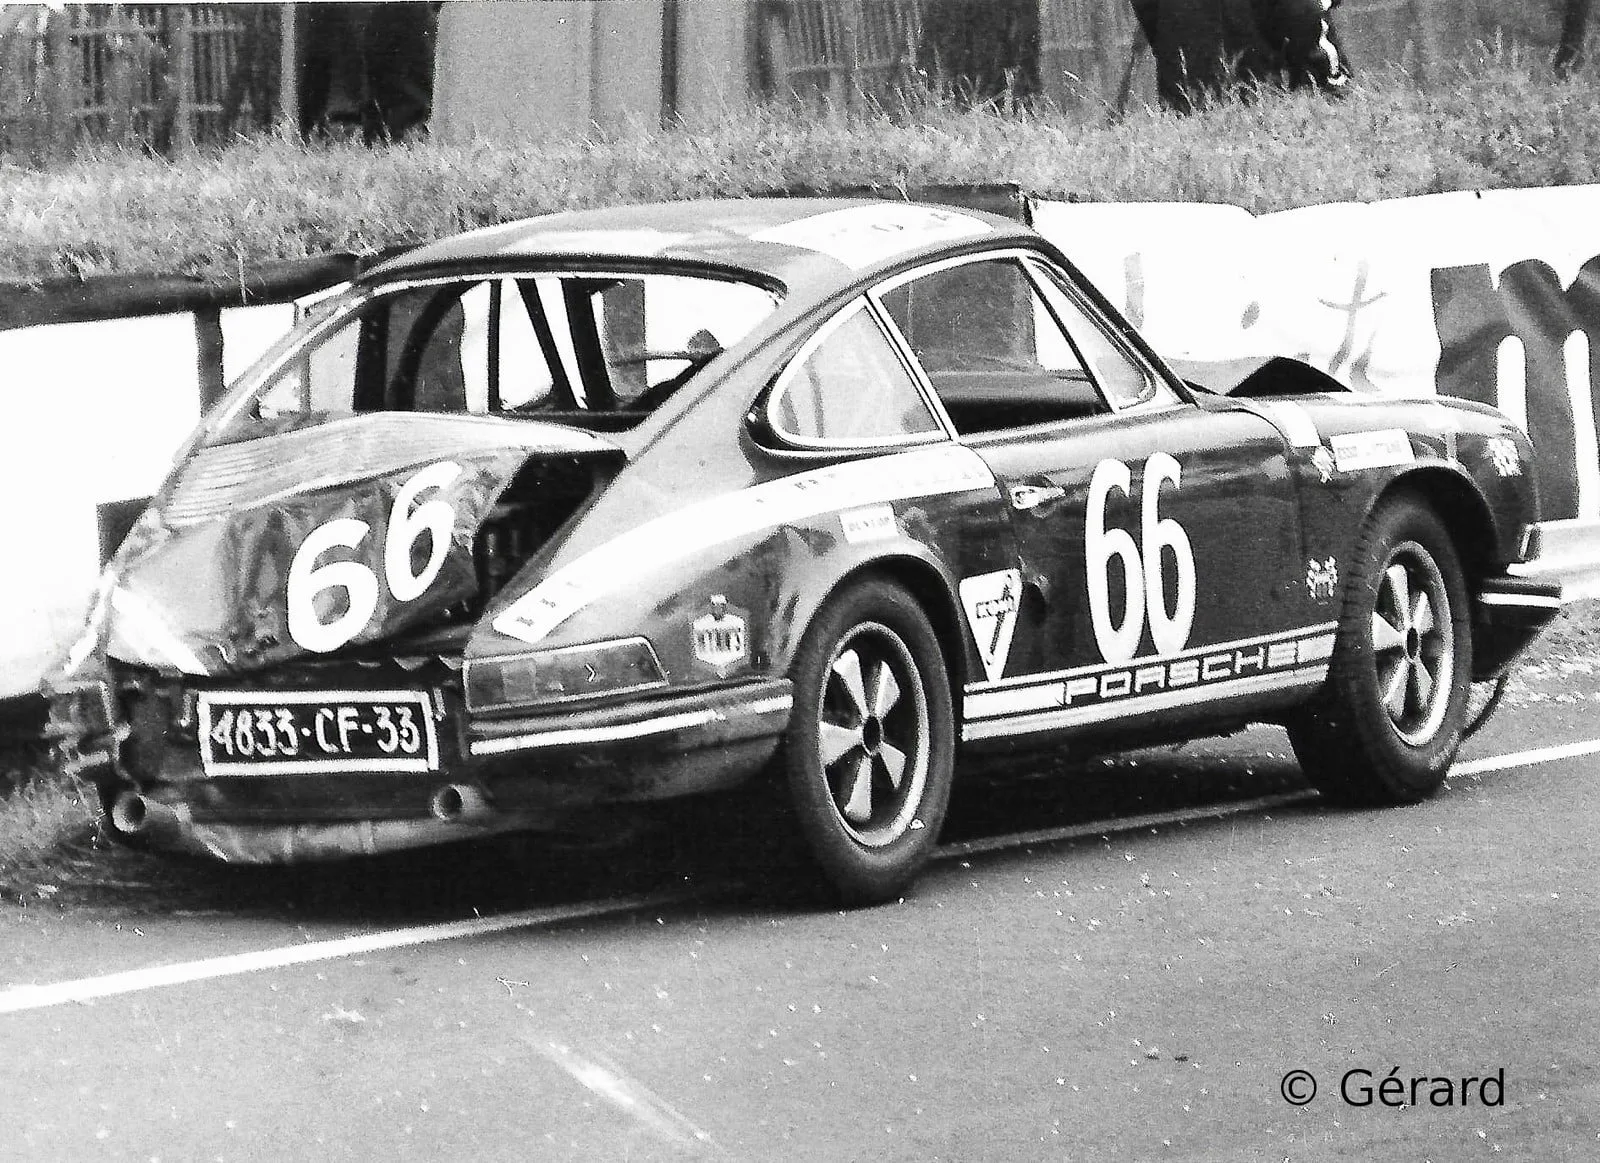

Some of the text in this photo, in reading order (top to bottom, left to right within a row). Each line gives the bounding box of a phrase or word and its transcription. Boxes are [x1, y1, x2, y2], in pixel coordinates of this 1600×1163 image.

[287, 460, 461, 653] 66
[1084, 452, 1196, 666] 66
[1063, 641, 1300, 706] PORSCHE
